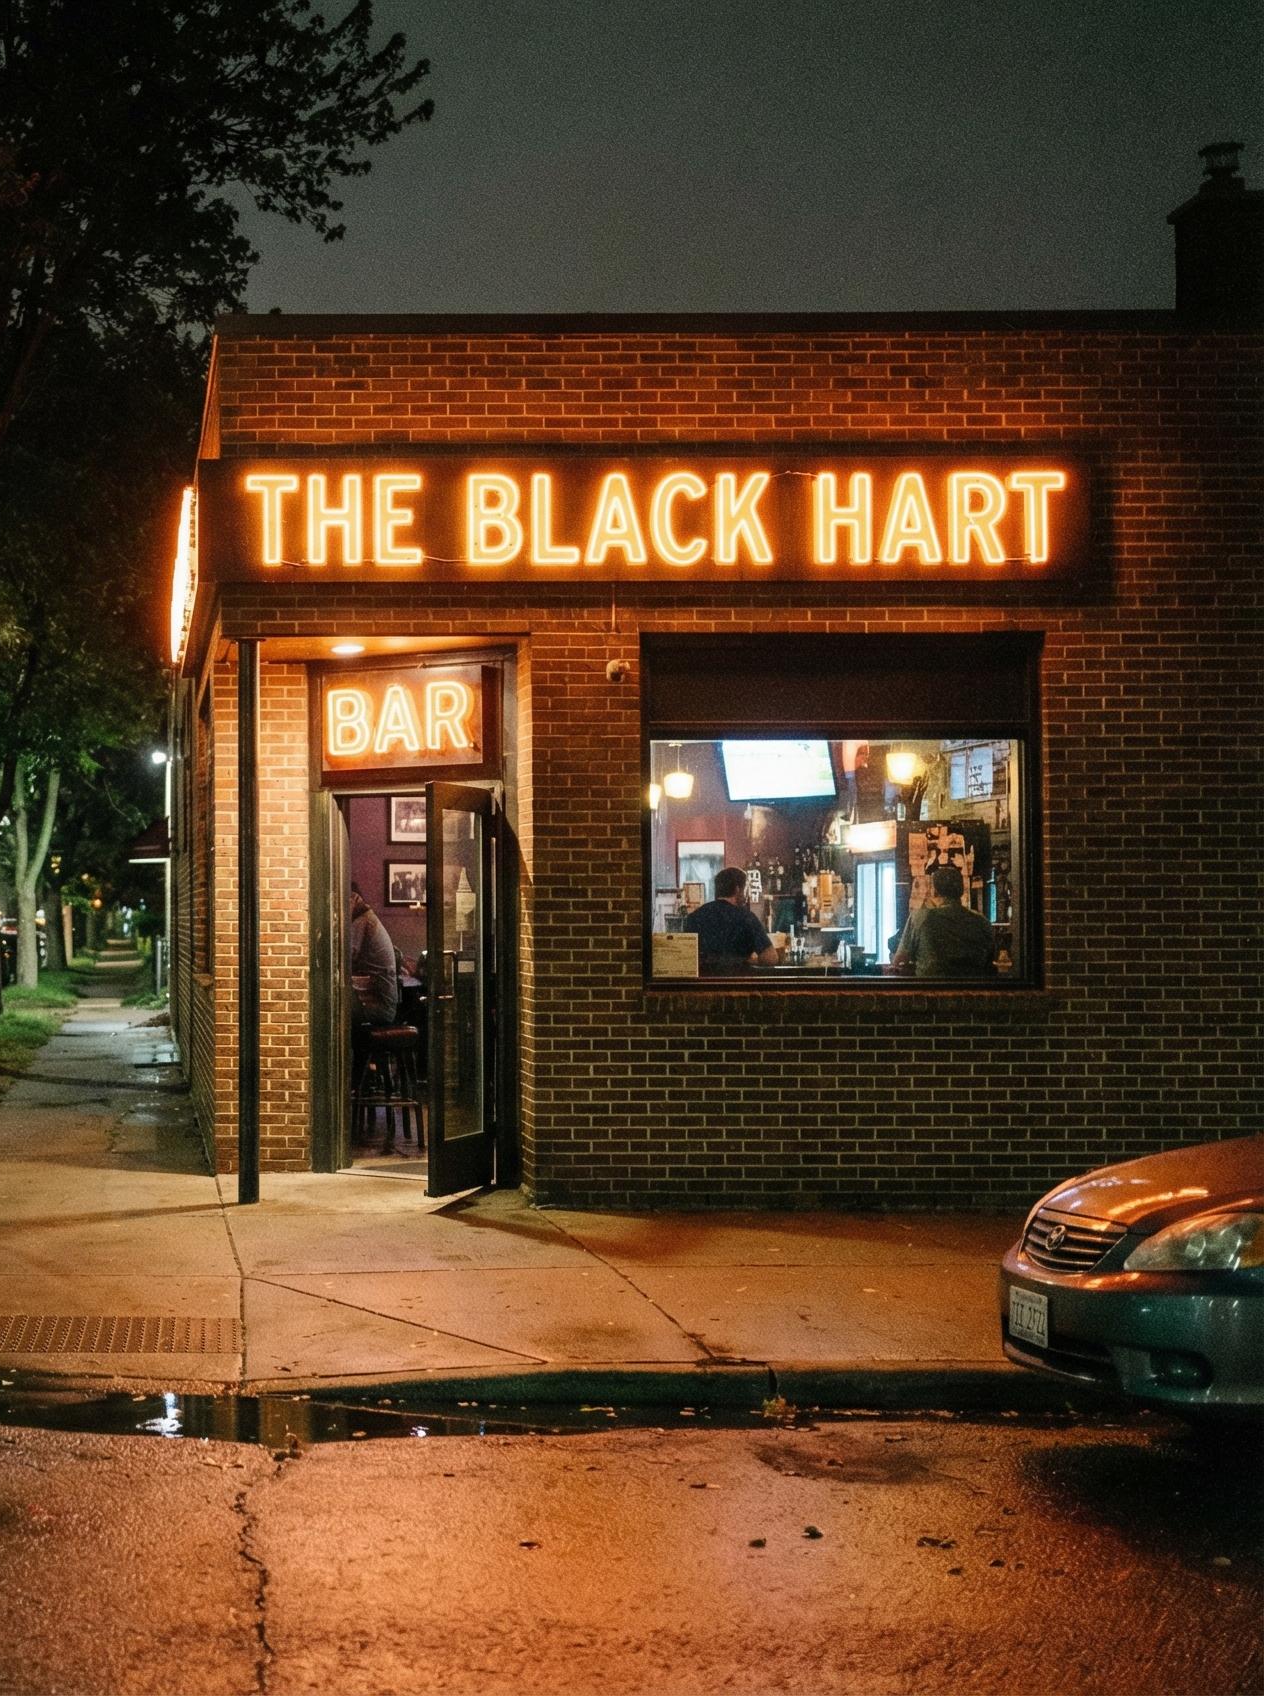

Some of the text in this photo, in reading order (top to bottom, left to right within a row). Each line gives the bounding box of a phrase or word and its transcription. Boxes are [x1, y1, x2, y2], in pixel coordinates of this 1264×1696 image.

[246, 472, 1066, 566] THE BLACK HART
[327, 680, 469, 756] BAR
